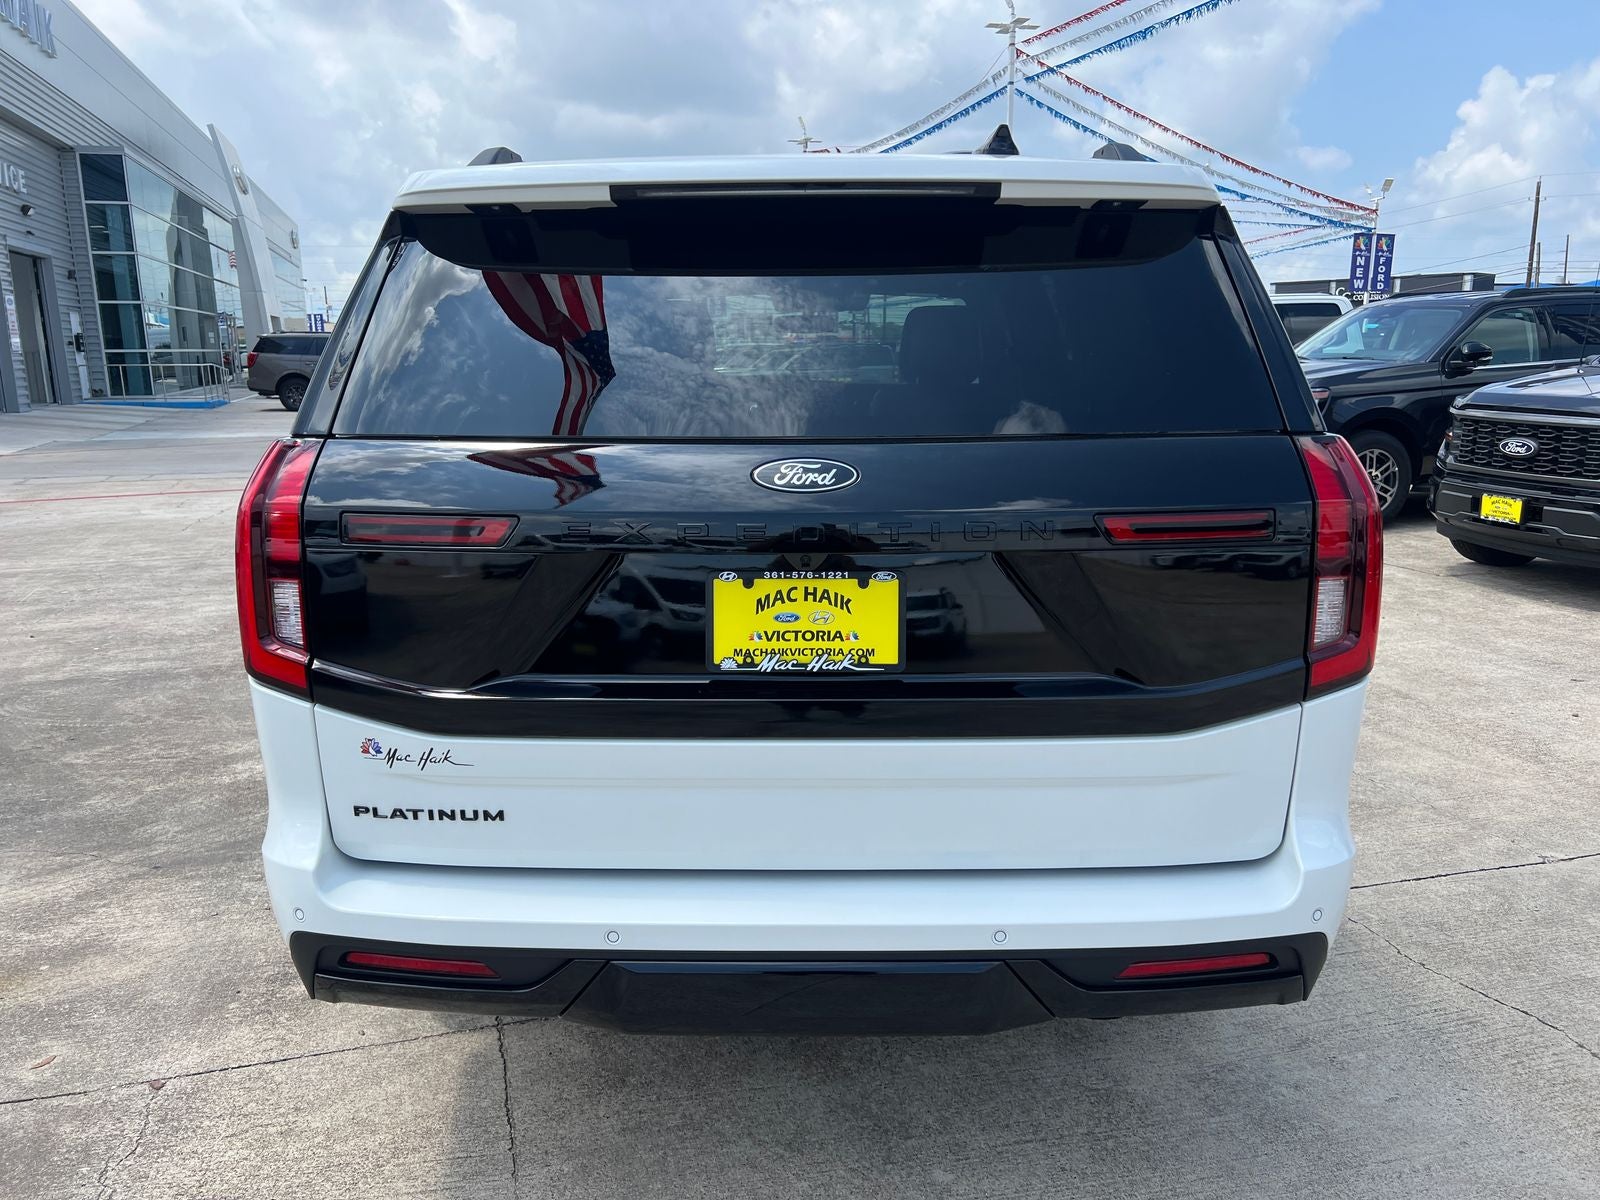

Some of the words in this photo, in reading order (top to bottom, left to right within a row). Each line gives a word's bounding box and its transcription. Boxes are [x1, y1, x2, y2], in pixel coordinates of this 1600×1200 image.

[1353, 256, 1366, 289] NEW
[1376, 257, 1386, 290] FORD
[774, 463, 837, 485] Ford
[560, 520, 1054, 543] EXPEDITION
[763, 571, 850, 579] 361-576-1221
[756, 586, 798, 615] MAC
[804, 586, 852, 615] HAIK
[763, 630, 845, 642] VICTORIA
[733, 647, 875, 657] MACHAIKVICTORIA.COM
[755, 653, 805, 673] Mac
[806, 653, 862, 673] Haik
[383, 748, 416, 768] Mac
[417, 747, 459, 771] Haik
[353, 805, 505, 822] PLATINUM
